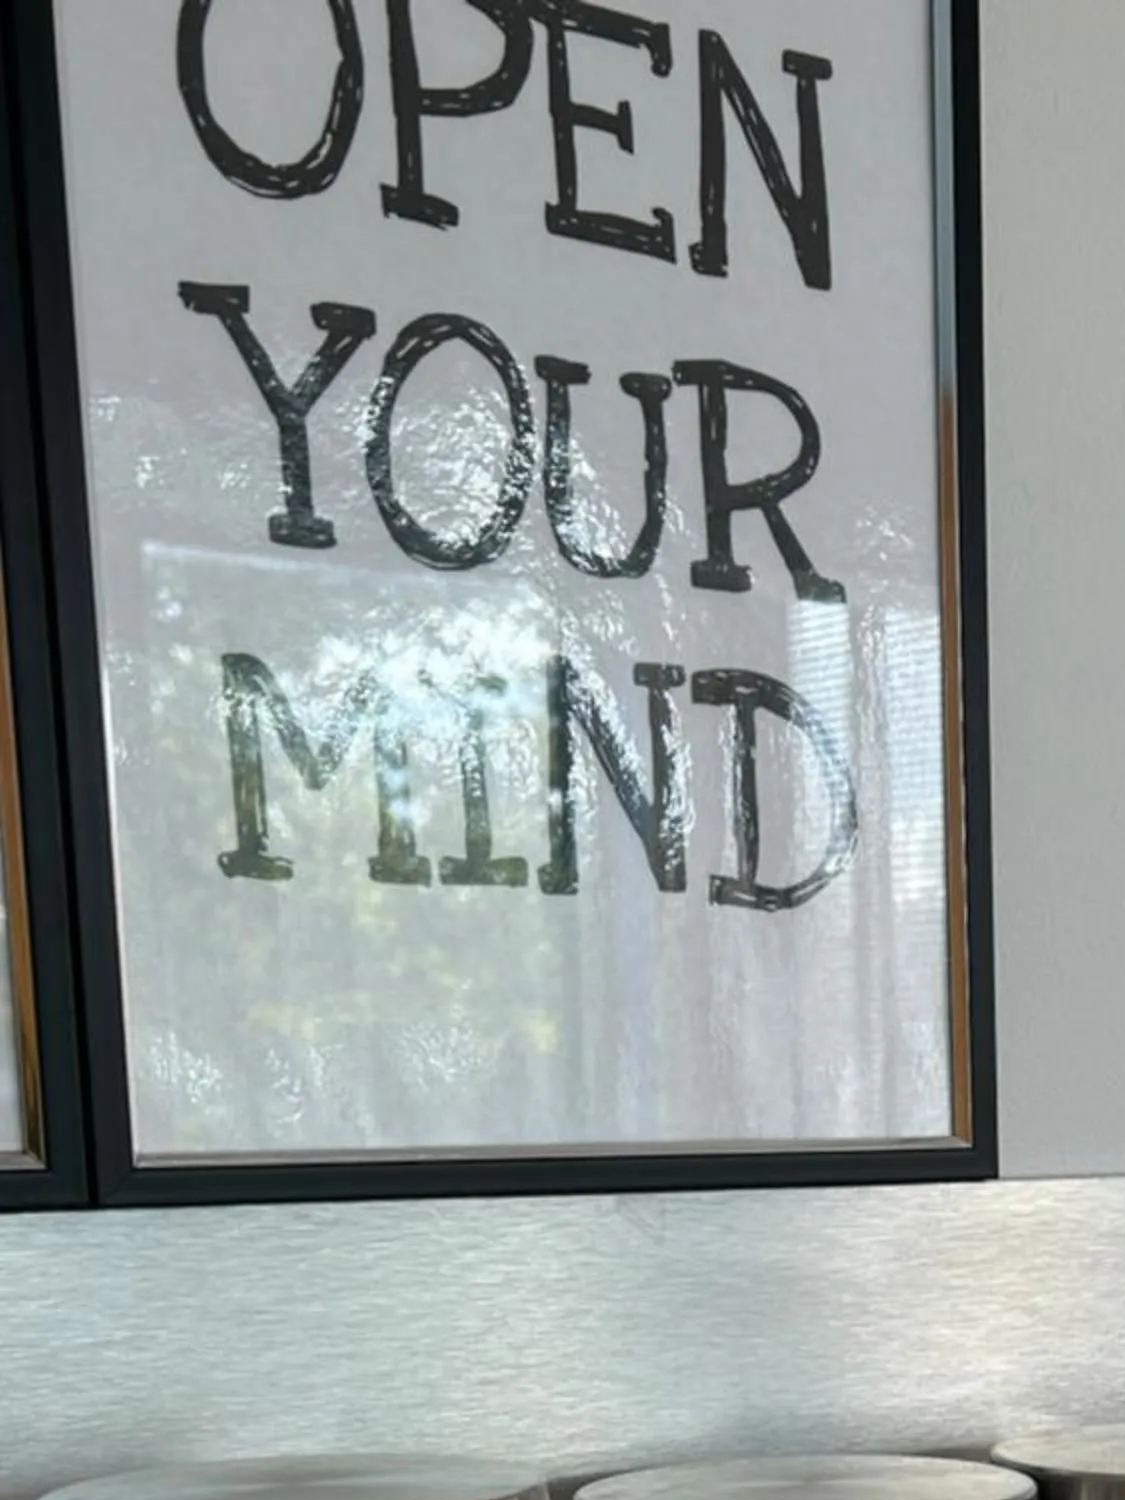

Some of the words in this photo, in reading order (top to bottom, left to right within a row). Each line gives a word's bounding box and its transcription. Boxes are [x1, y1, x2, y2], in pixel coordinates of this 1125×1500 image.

[176, 0, 832, 290] OPEN
[178, 280, 847, 603] YOUR
[217, 652, 859, 913] MIND
